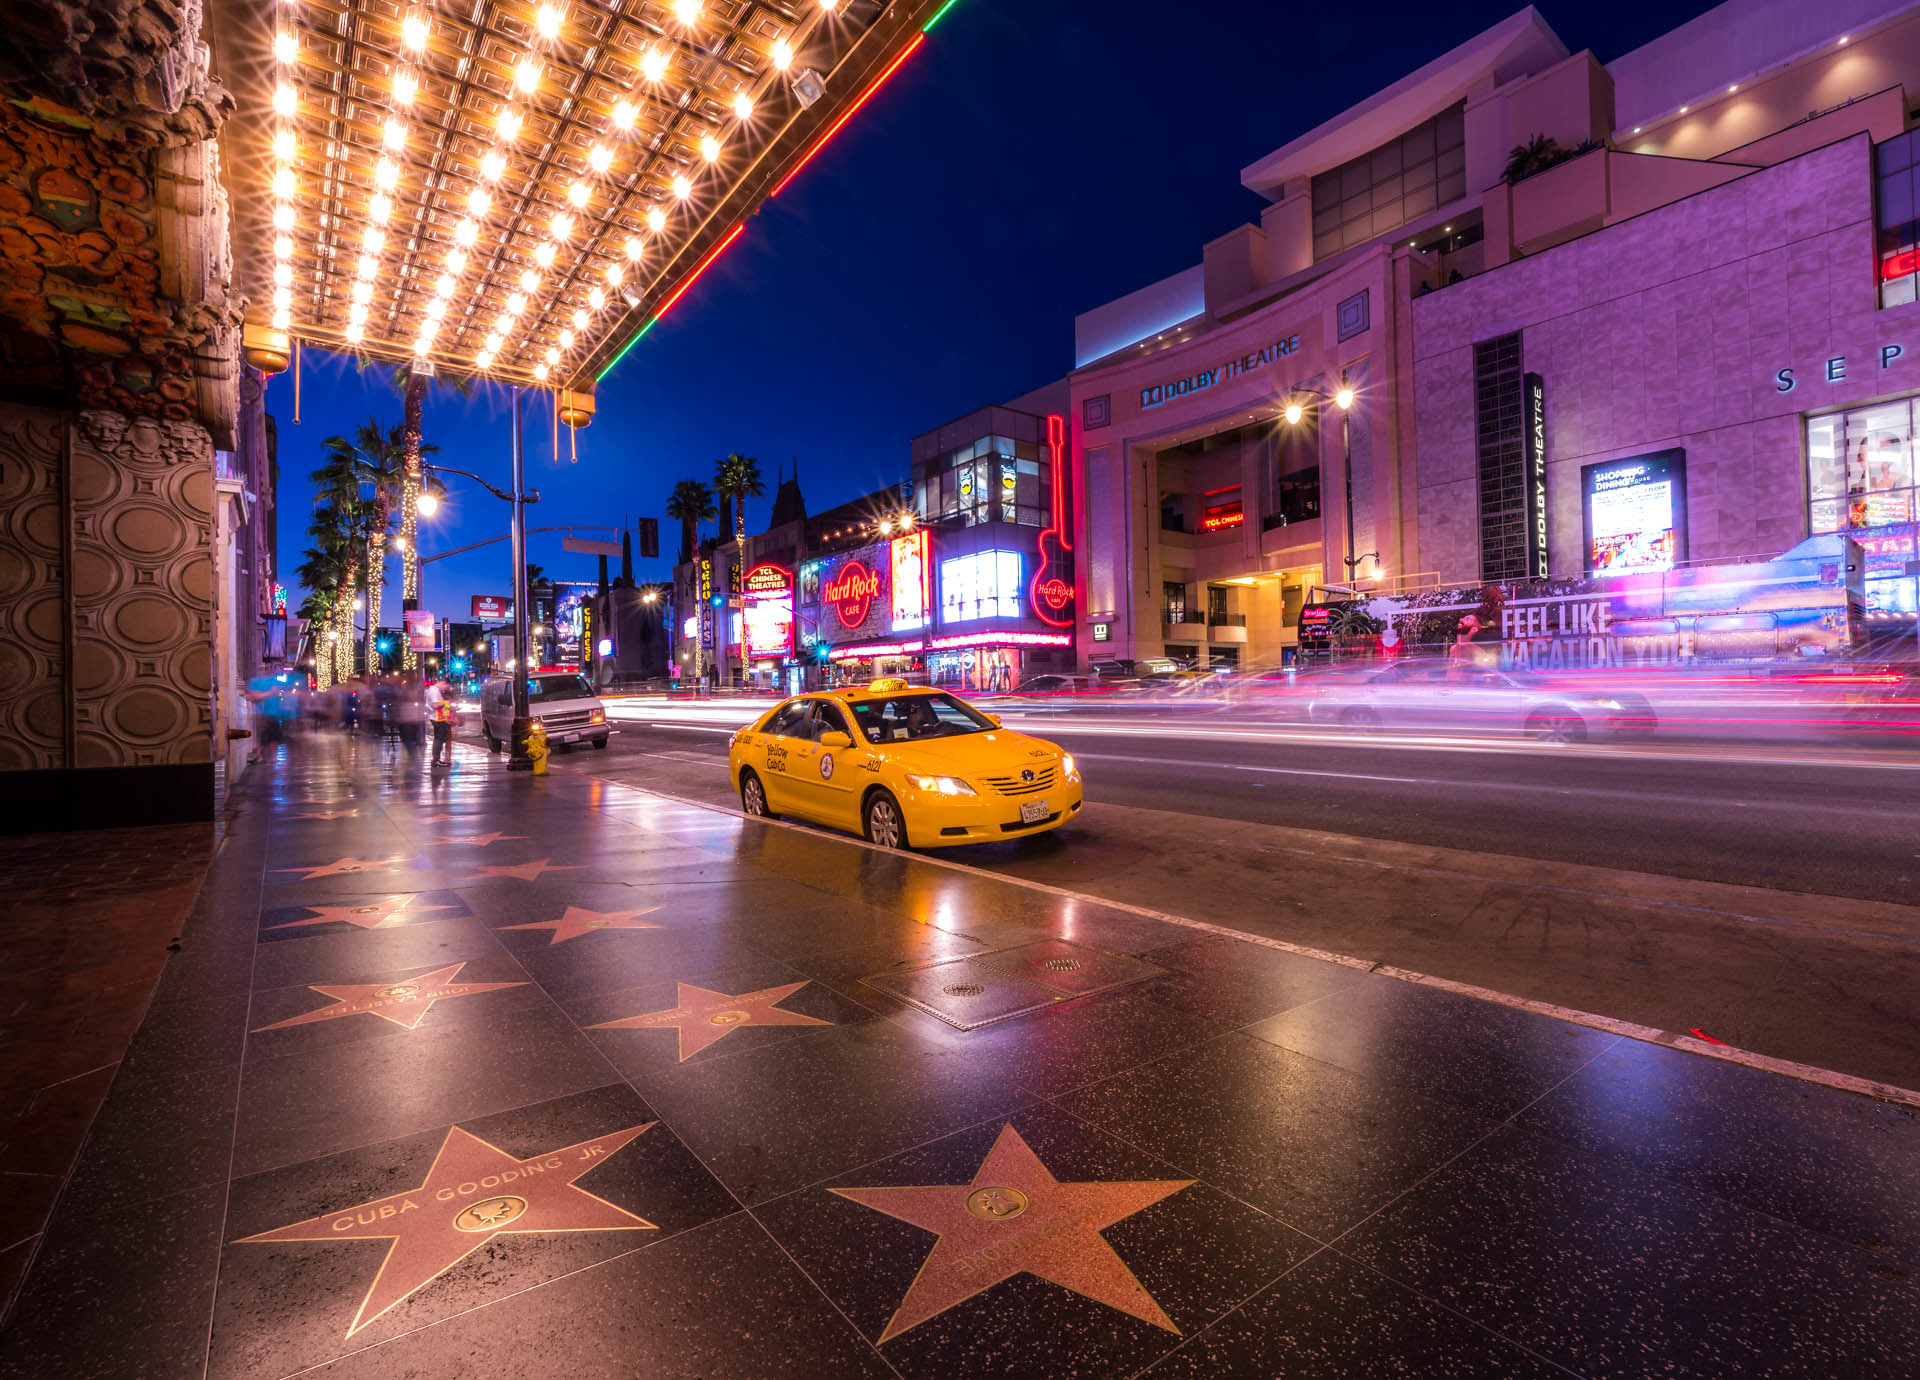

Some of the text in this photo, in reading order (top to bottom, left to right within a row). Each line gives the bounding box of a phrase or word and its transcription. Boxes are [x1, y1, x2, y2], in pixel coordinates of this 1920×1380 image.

[1165, 333, 1302, 401] DOLBY THEATRE
[1534, 385, 1547, 549] DOLBY THEATRE
[1205, 518, 1221, 527] TCL
[747, 580, 786, 590] THEATRES
[750, 574, 782, 584] CHINESE
[824, 569, 879, 603] Hard Rock
[1038, 583, 1075, 599] Hard Rock
[844, 605, 860, 616] CAFE
[1502, 601, 1612, 639] FEEL LIKE
[1501, 636, 1624, 672] VACATION
[767, 744, 788, 760] Yellow
[332, 1143, 606, 1232] CUBA GOODING JR
